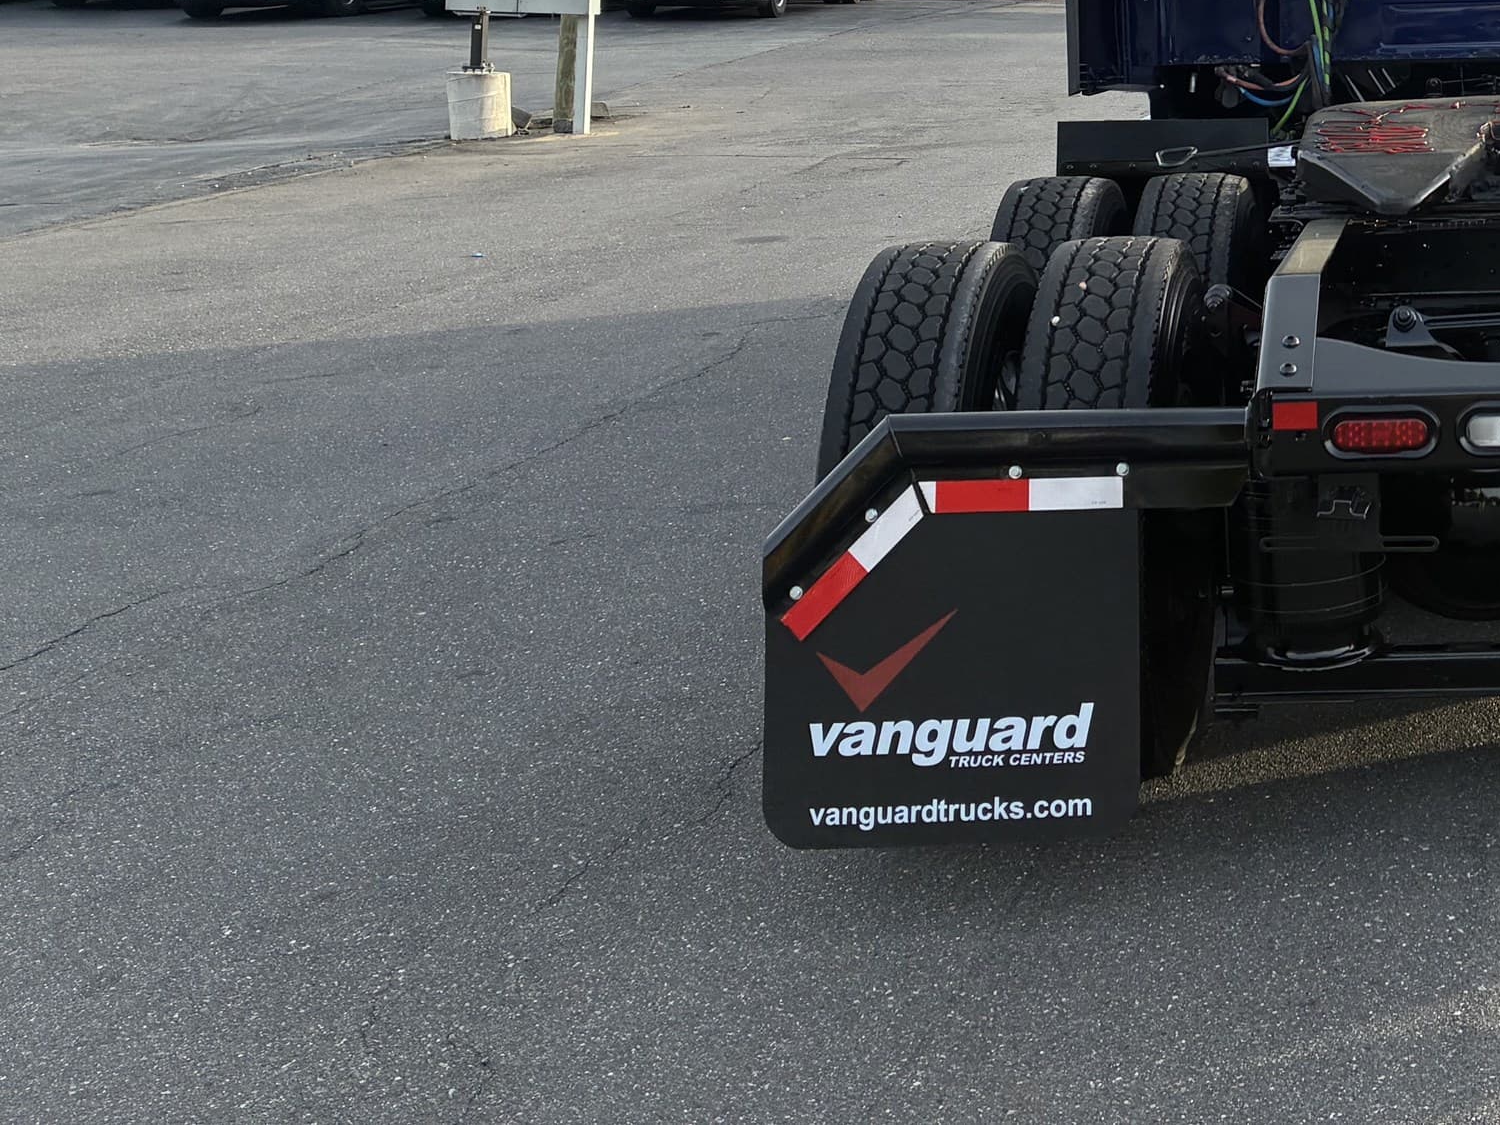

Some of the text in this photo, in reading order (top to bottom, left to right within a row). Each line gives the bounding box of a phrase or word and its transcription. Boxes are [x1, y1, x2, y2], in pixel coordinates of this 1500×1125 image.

[809, 702, 1095, 767] vanguard
[948, 751, 1086, 768] TRUCK CENTERS
[809, 796, 1093, 831] vanguardtrucks.com
